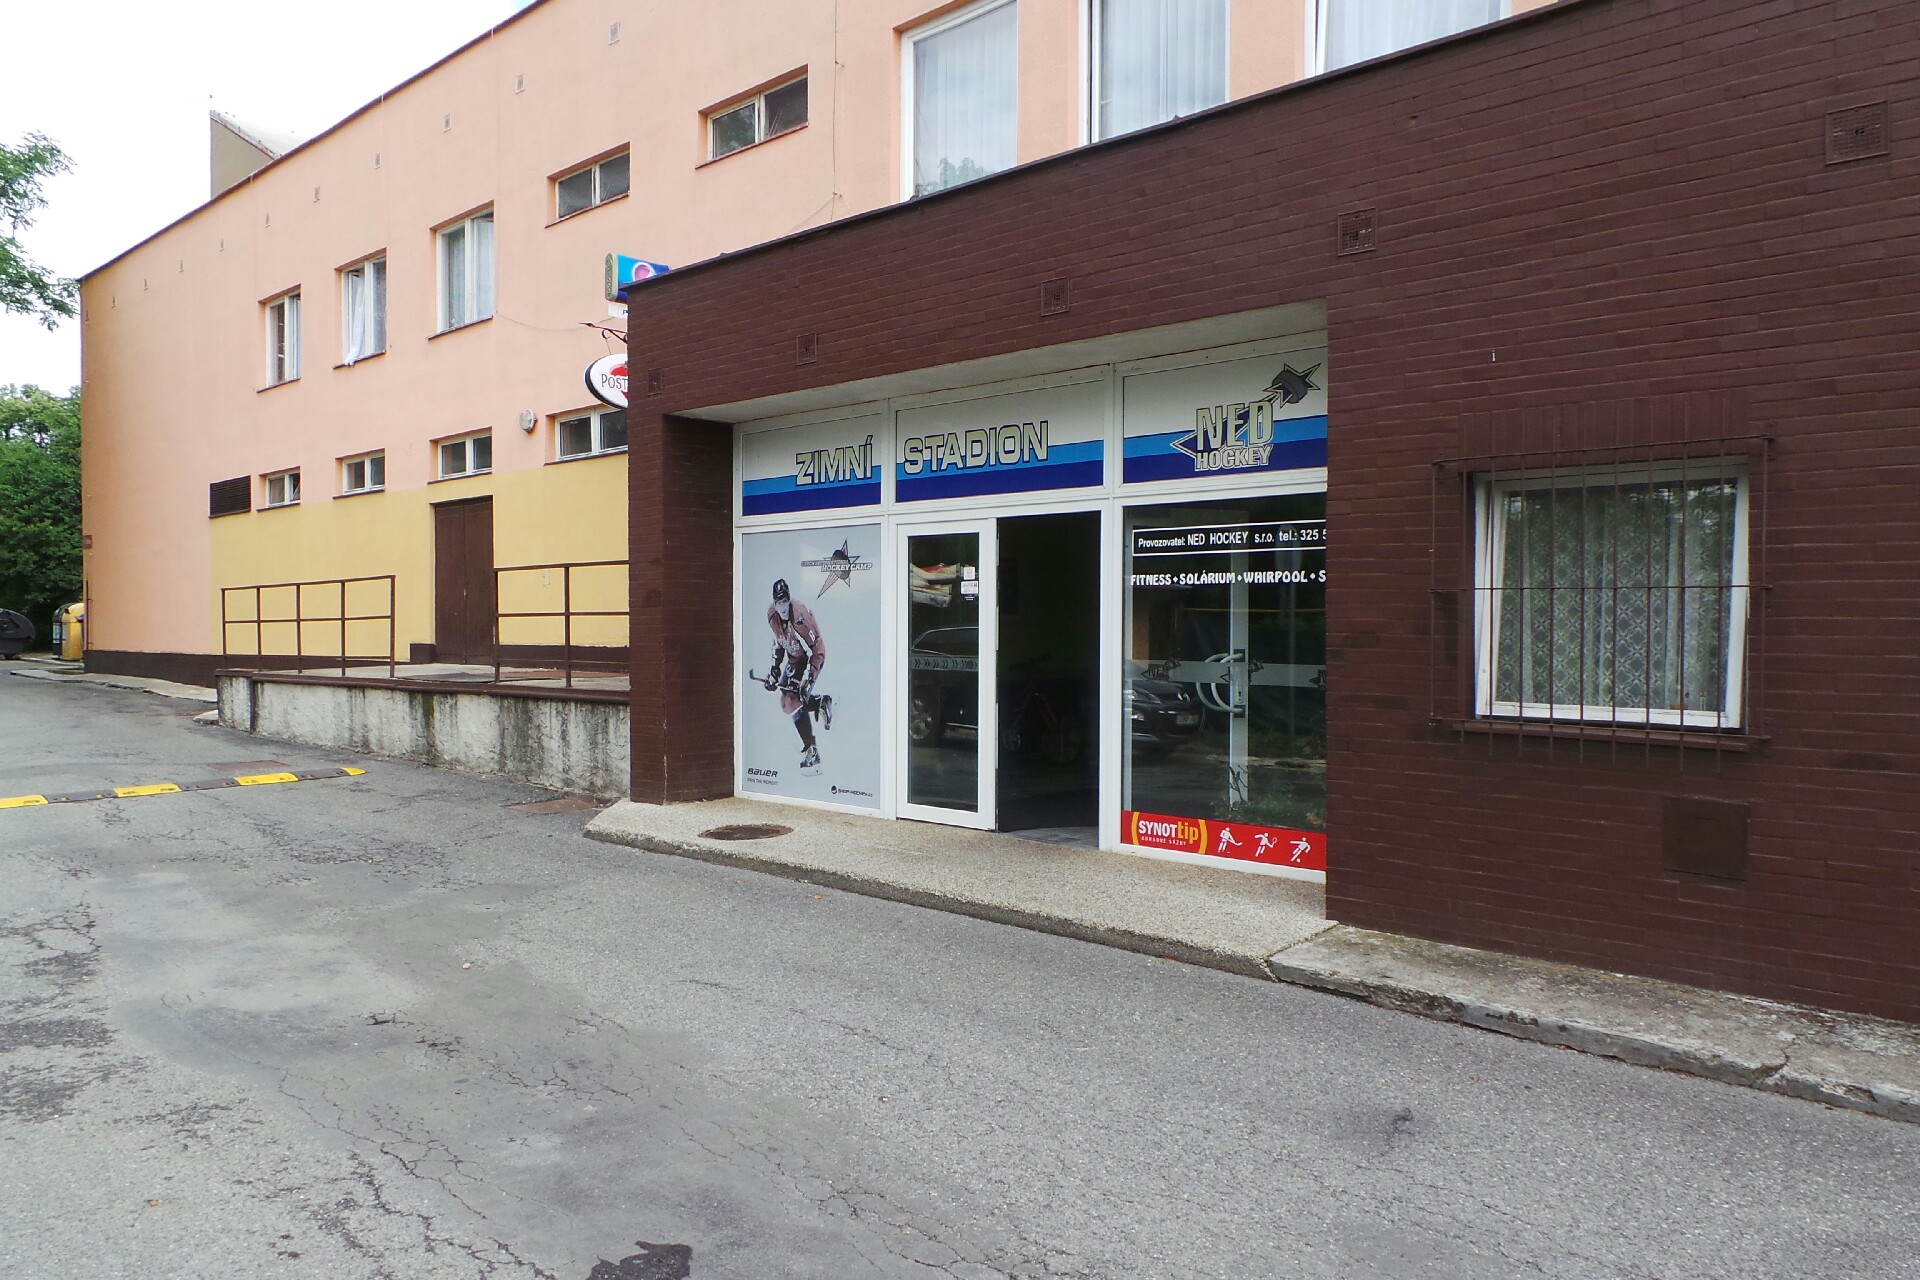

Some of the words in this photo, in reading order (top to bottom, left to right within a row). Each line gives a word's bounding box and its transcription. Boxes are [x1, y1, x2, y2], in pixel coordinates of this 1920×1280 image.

[1195, 401, 1274, 450] NED
[795, 435, 873, 487] ZIMNÍ
[903, 420, 1049, 475] STADION
[1195, 445, 1274, 470] HOCKEY
[1138, 537, 1185, 548] Provozovatel:
[1187, 534, 1205, 546] NED
[1209, 532, 1249, 545] HOCKEY
[1255, 532, 1274, 543] s.r.o.
[1279, 530, 1298, 542] tel.:
[1300, 529, 1319, 541] 325
[822, 563, 850, 571] HOCKEY
[850, 563, 873, 571] CAMP
[1131, 574, 1172, 586] FITNESS
[1179, 570, 1236, 584] SOLÁRIUM
[1243, 571, 1308, 584] WHIRPOOL
